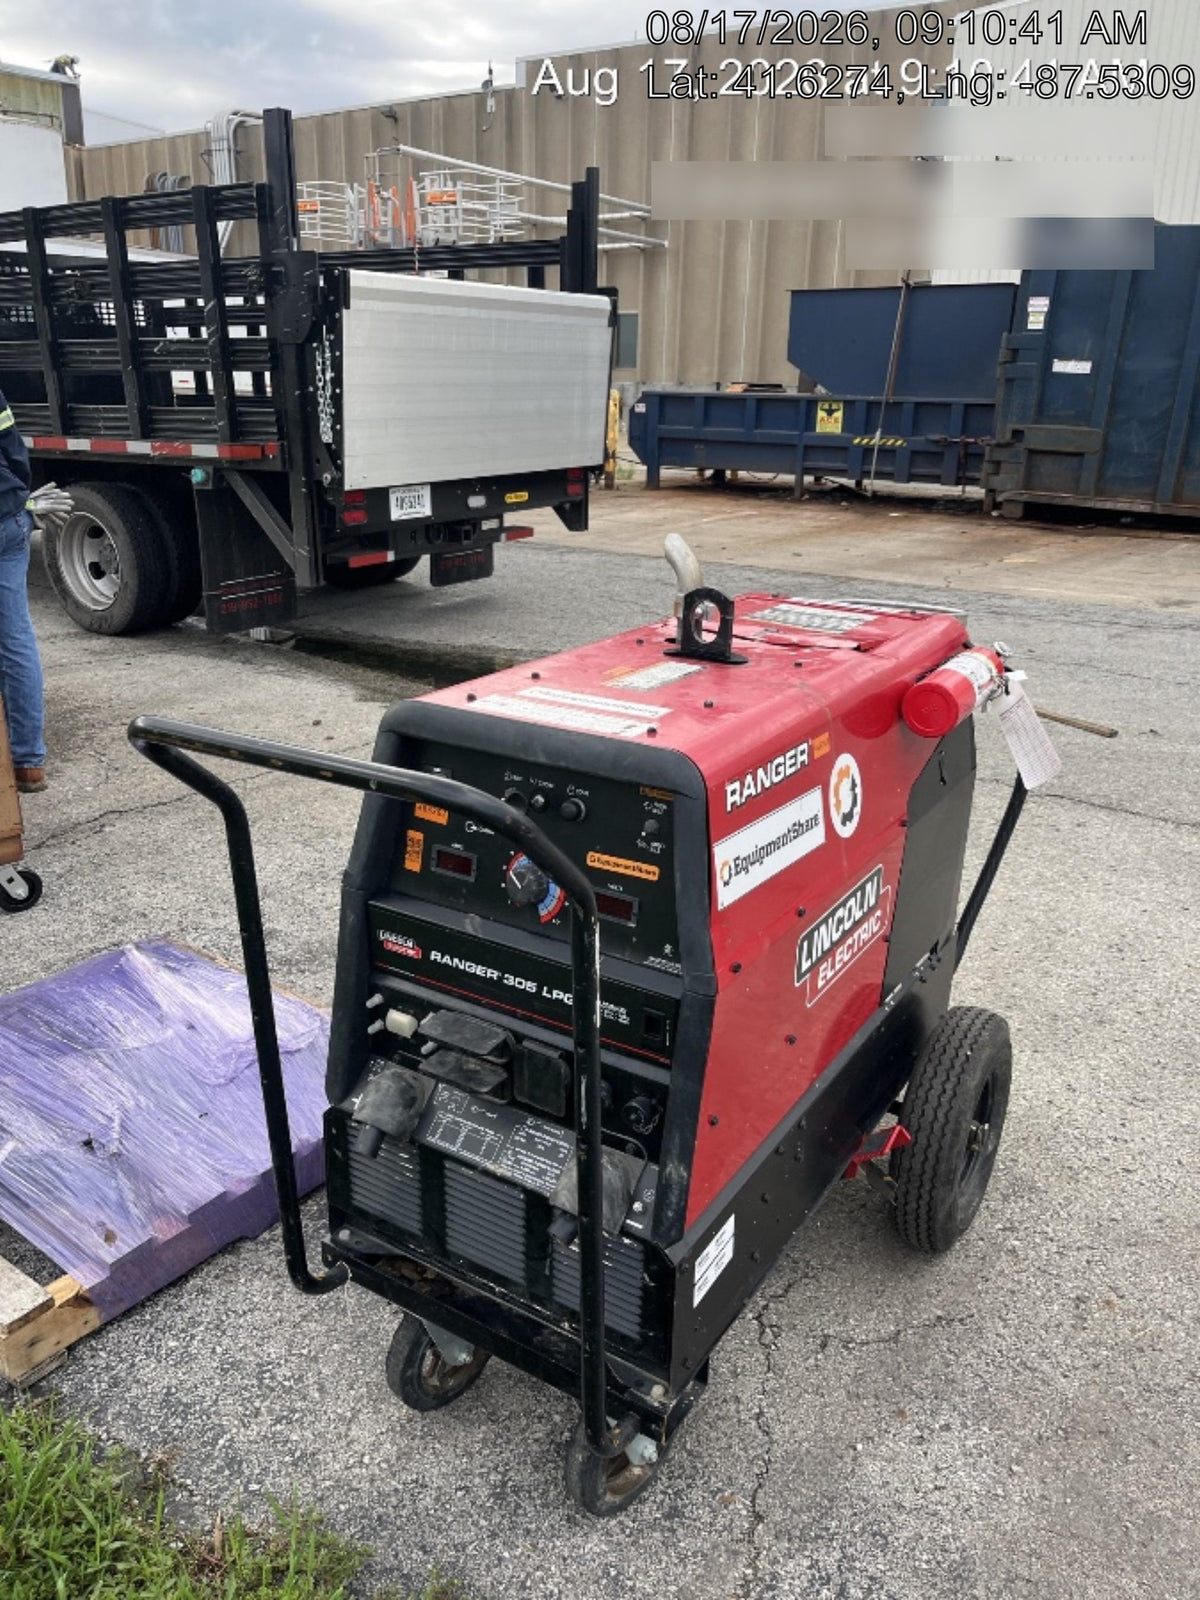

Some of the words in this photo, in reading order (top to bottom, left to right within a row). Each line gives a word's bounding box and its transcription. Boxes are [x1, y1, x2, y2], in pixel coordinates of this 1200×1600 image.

[725, 740, 810, 813] RANGER
[733, 812, 820, 877] EquipmentShare
[800, 875, 878, 973] LINCOLN
[817, 909, 882, 989] ELECTRIC
[429, 950, 498, 981] RANGER
